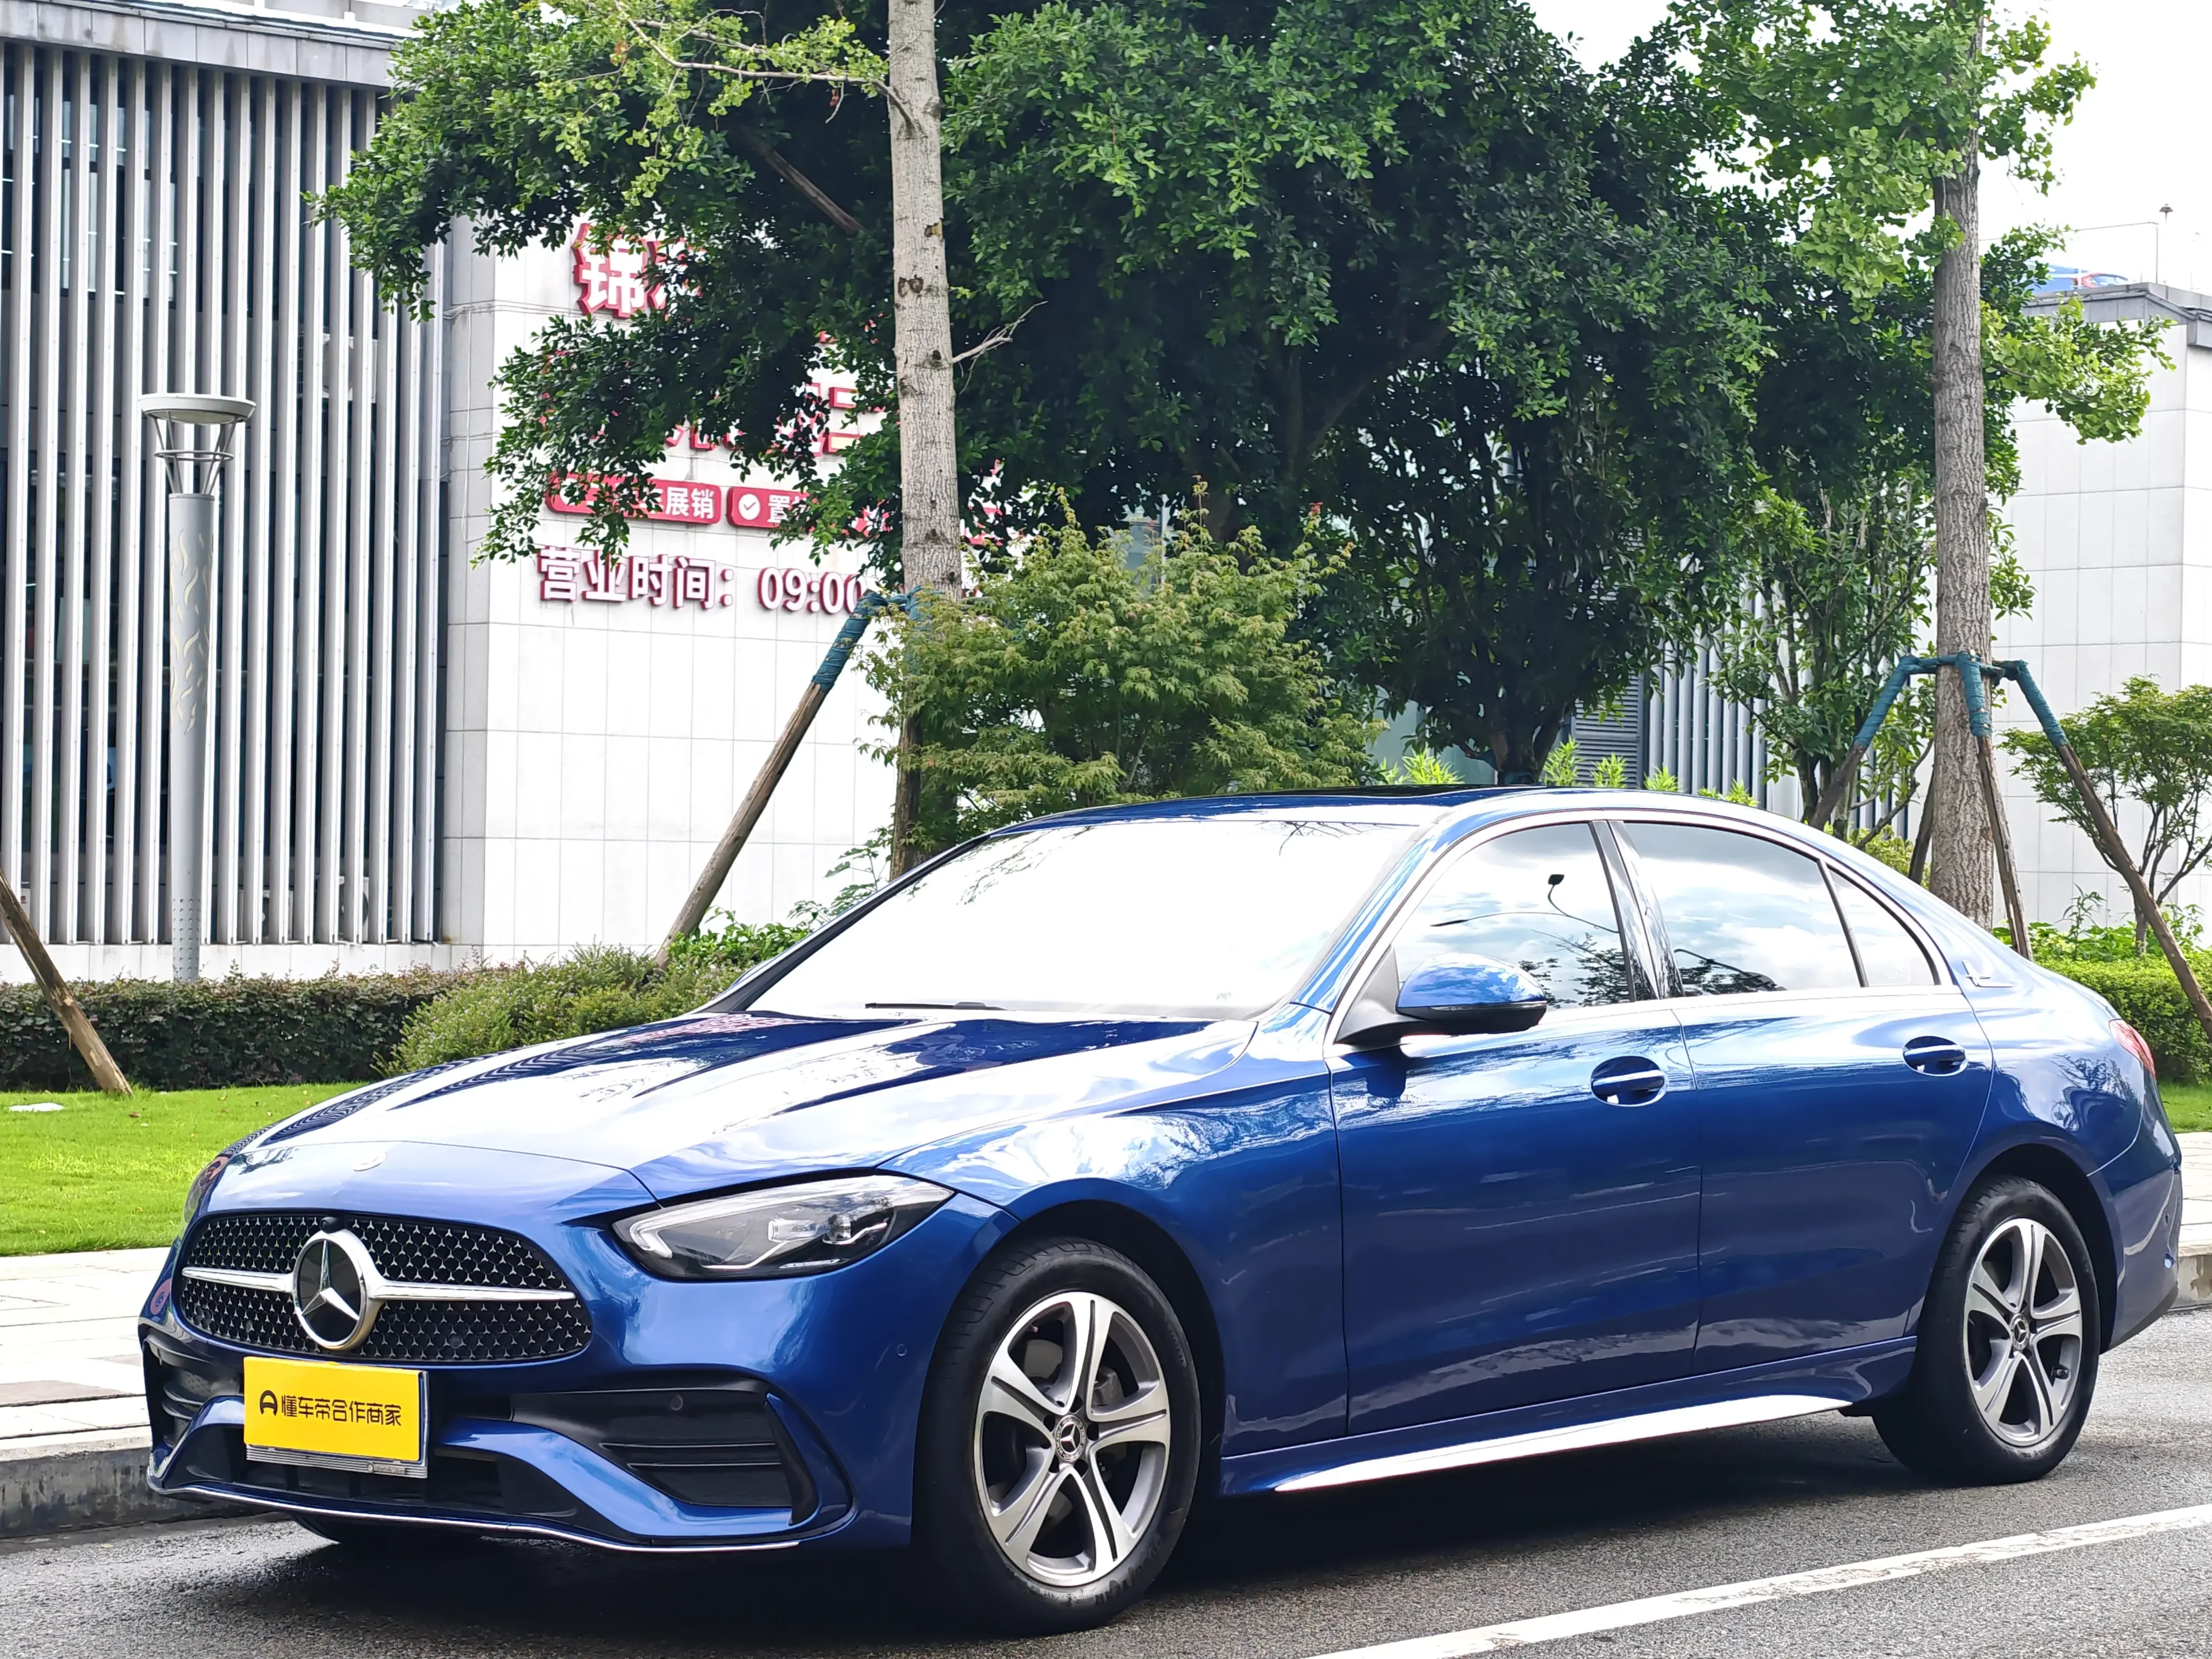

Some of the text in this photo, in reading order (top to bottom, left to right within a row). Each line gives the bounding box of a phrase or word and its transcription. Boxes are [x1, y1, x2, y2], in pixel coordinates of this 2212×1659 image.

[281, 1394, 402, 1427] 懂车帝合作商家
